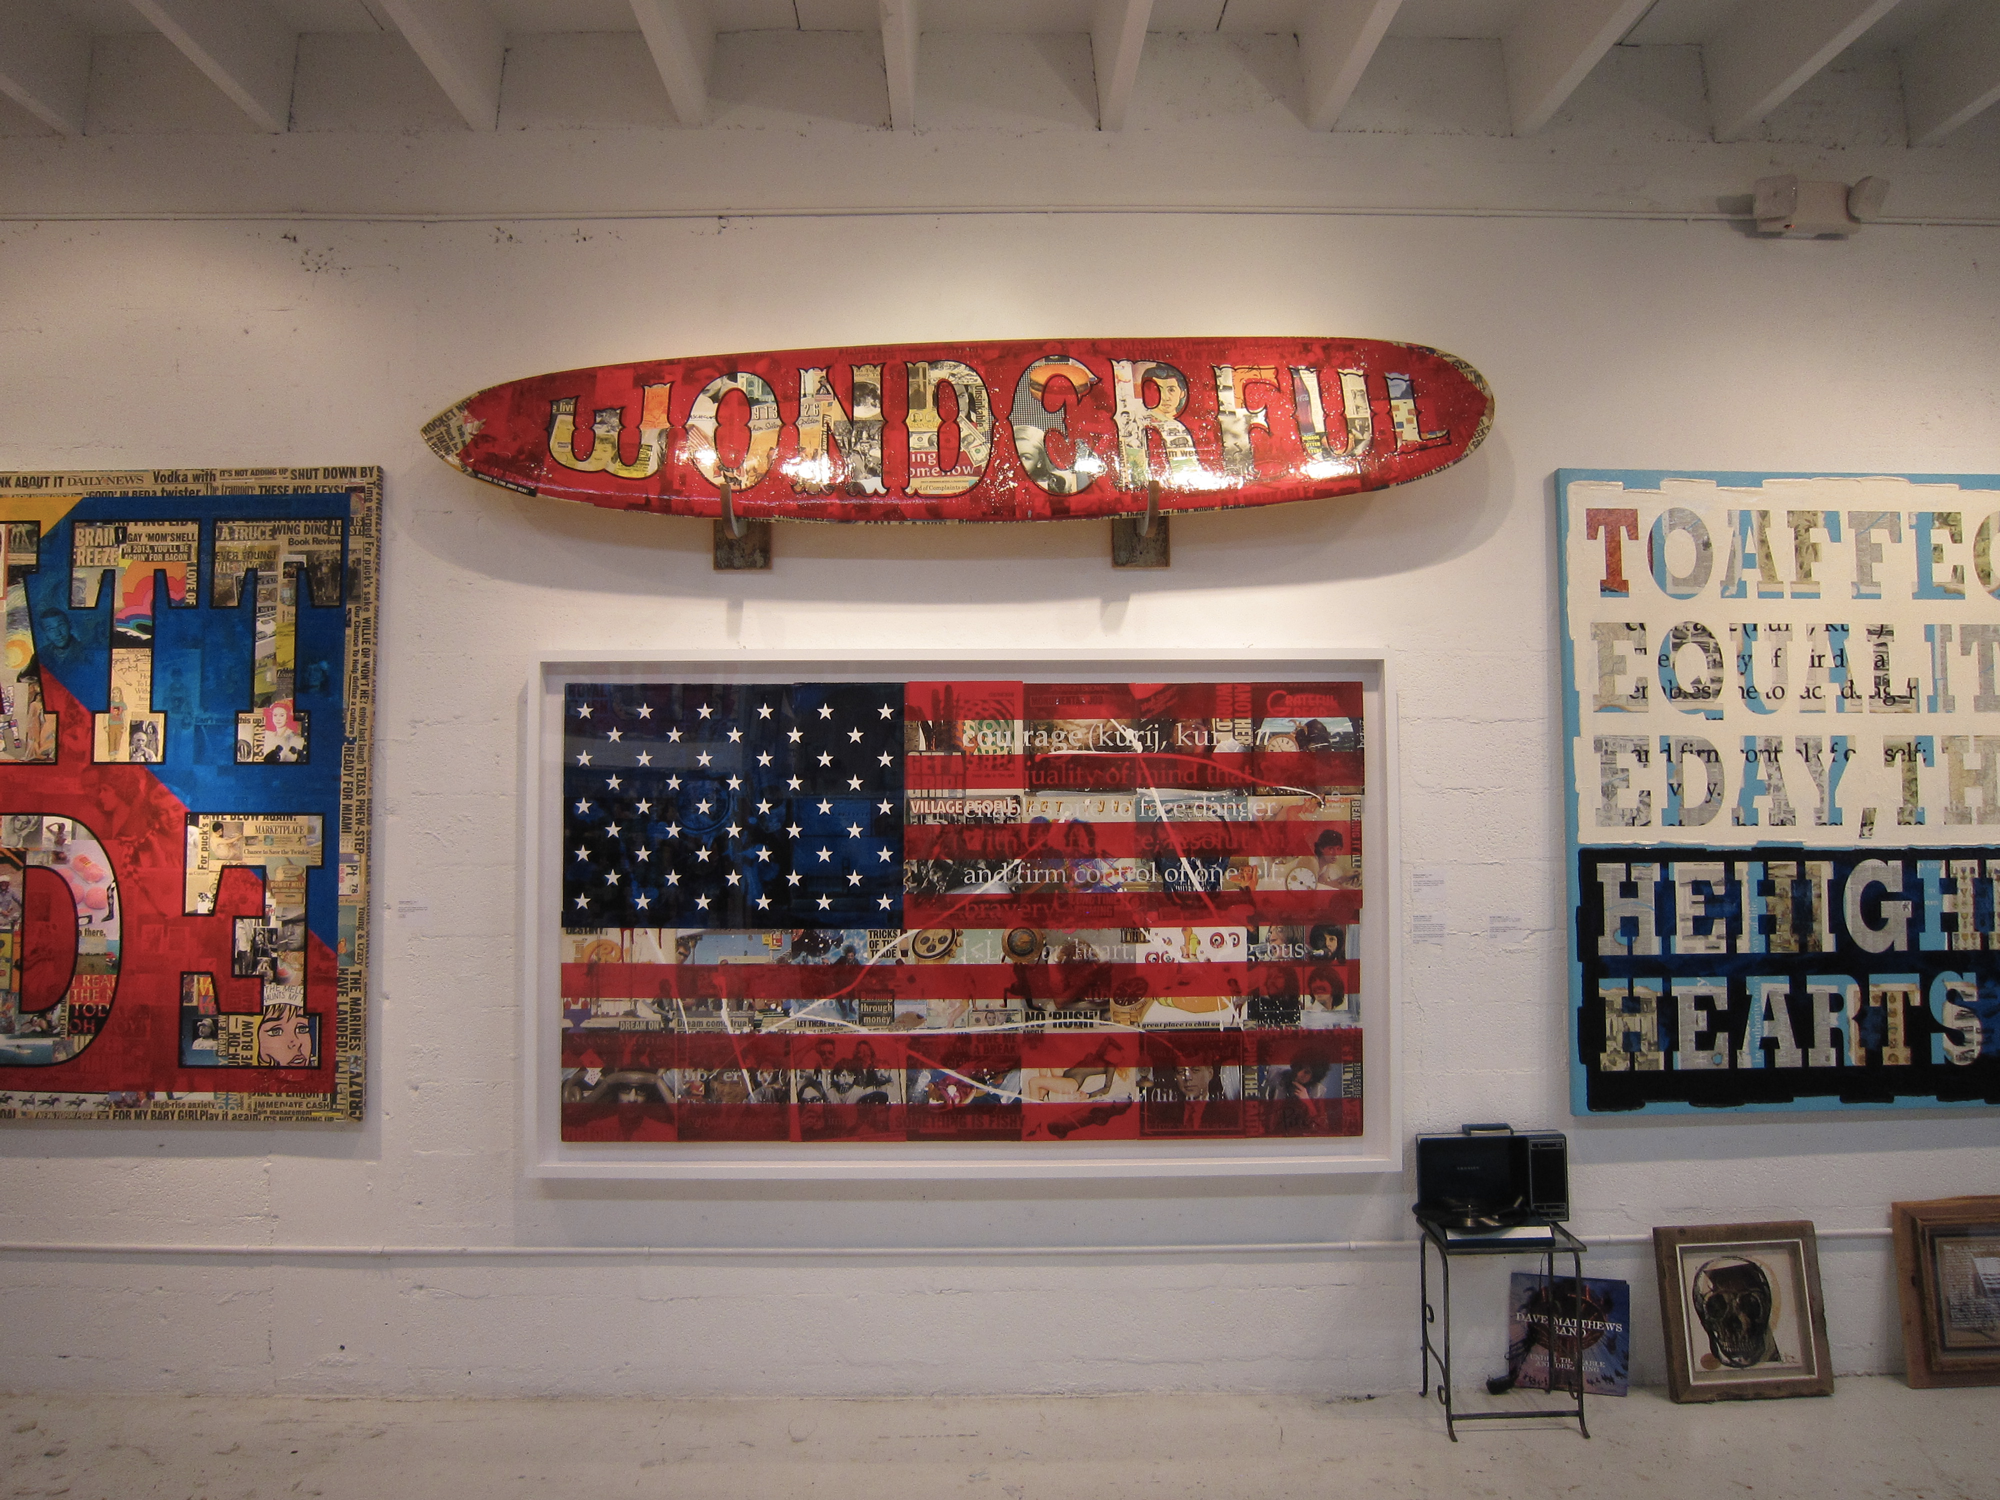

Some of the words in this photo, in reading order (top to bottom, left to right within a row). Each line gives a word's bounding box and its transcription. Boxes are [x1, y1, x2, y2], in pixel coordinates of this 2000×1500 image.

[974, 385, 984, 428] Unsinkable
[421, 409, 457, 436] ROCKET
[434, 432, 455, 457] TAKING
[67, 476, 104, 486] DAILY
[106, 475, 144, 486] NEWS
[153, 471, 188, 483] Vodka
[192, 470, 216, 483] with
[234, 469, 248, 477] NOT
[250, 469, 277, 477] ADDING
[278, 468, 289, 476] UP
[290, 468, 320, 480] SHUT
[323, 467, 357, 479] DOWN
[361, 467, 375, 479] BY
[14, 476, 51, 489] ABOUT
[53, 476, 64, 488] IT
[258, 486, 290, 495] THESE
[366, 481, 377, 503] Time
[362, 505, 374, 539] warped
[127, 534, 143, 542] GAY
[234, 525, 275, 540] TRUCE
[179, 545, 189, 553] BE
[288, 538, 309, 546] Book
[364, 541, 375, 557] For
[149, 553, 163, 561] FOR
[164, 553, 188, 561] BACON
[186, 566, 198, 590] LOVE
[361, 559, 373, 588] puck's
[186, 592, 198, 605] OF
[362, 591, 373, 613] sake
[353, 606, 363, 618] Our
[351, 620, 361, 647] Chance
[360, 616, 373, 646] WILLIE
[351, 648, 361, 657] To
[361, 647, 371, 659] OR
[350, 658, 361, 675] Help
[360, 660, 372, 687] WON'T
[350, 675, 361, 699] define
[359, 689, 371, 704] HE?
[252, 716, 265, 726] up!
[1235, 684, 1252, 745] ANOTHER
[357, 727, 369, 743] last
[962, 728, 1084, 752] courage
[342, 746, 356, 778] READY
[356, 743, 368, 765] laugh
[908, 751, 938, 771] GET
[355, 766, 367, 796] TEXAS
[342, 780, 354, 800] FOR
[909, 799, 963, 815] VILLAGE
[964, 799, 1019, 815] PEOPLE
[1139, 794, 1184, 817] face
[1191, 794, 1277, 822] danger
[341, 803, 354, 834] MIAMI
[354, 798, 367, 855] PHEW-STEP
[1351, 800, 1362, 838] BEARING
[198, 822, 210, 853] puck's
[254, 824, 305, 835] MARKETPLACE
[197, 854, 208, 871] For
[1351, 851, 1362, 868] ALL
[345, 864, 359, 877] Pt
[963, 862, 1010, 884] and
[1015, 862, 1067, 884] firm
[351, 883, 359, 895] 78
[355, 906, 366, 932] Young
[357, 933, 365, 941] &
[868, 929, 899, 939] TRICKS
[868, 940, 881, 949] OF
[354, 942, 365, 967] Crazy
[337, 967, 350, 998] HAVE
[349, 969, 362, 993] THE
[72, 988, 100, 1002] THE
[860, 1003, 893, 1013] through
[68, 1019, 96, 1034] OH
[335, 1001, 350, 1054] LANDED!
[348, 996, 362, 1052] MARINES
[619, 1020, 648, 1031] DREAM
[648, 1020, 660, 1030] ON
[677, 1018, 704, 1028] Dream
[796, 1019, 808, 1028] LET
[863, 1016, 891, 1025] money
[1024, 1010, 1046, 1028] NO
[1048, 1010, 1098, 1029] 'RUSH'
[1162, 1021, 1185, 1029] place
[240, 1020, 253, 1051] BLOW
[1244, 1071, 1258, 1097] THE
[152, 1101, 186, 1109] High-rise
[254, 1101, 304, 1109] IMMEDIATE
[305, 1101, 330, 1109] CASH
[112, 1110, 133, 1121] FOR
[134, 1110, 150, 1121] MY
[150, 1110, 175, 1121] BABY
[177, 1110, 200, 1121] GIRL
[200, 1110, 220, 1121] Play
[221, 1110, 230, 1121] it
[1515, 1312, 1549, 1323] DAVE
[1553, 1316, 1623, 1333] MATTHEWS
